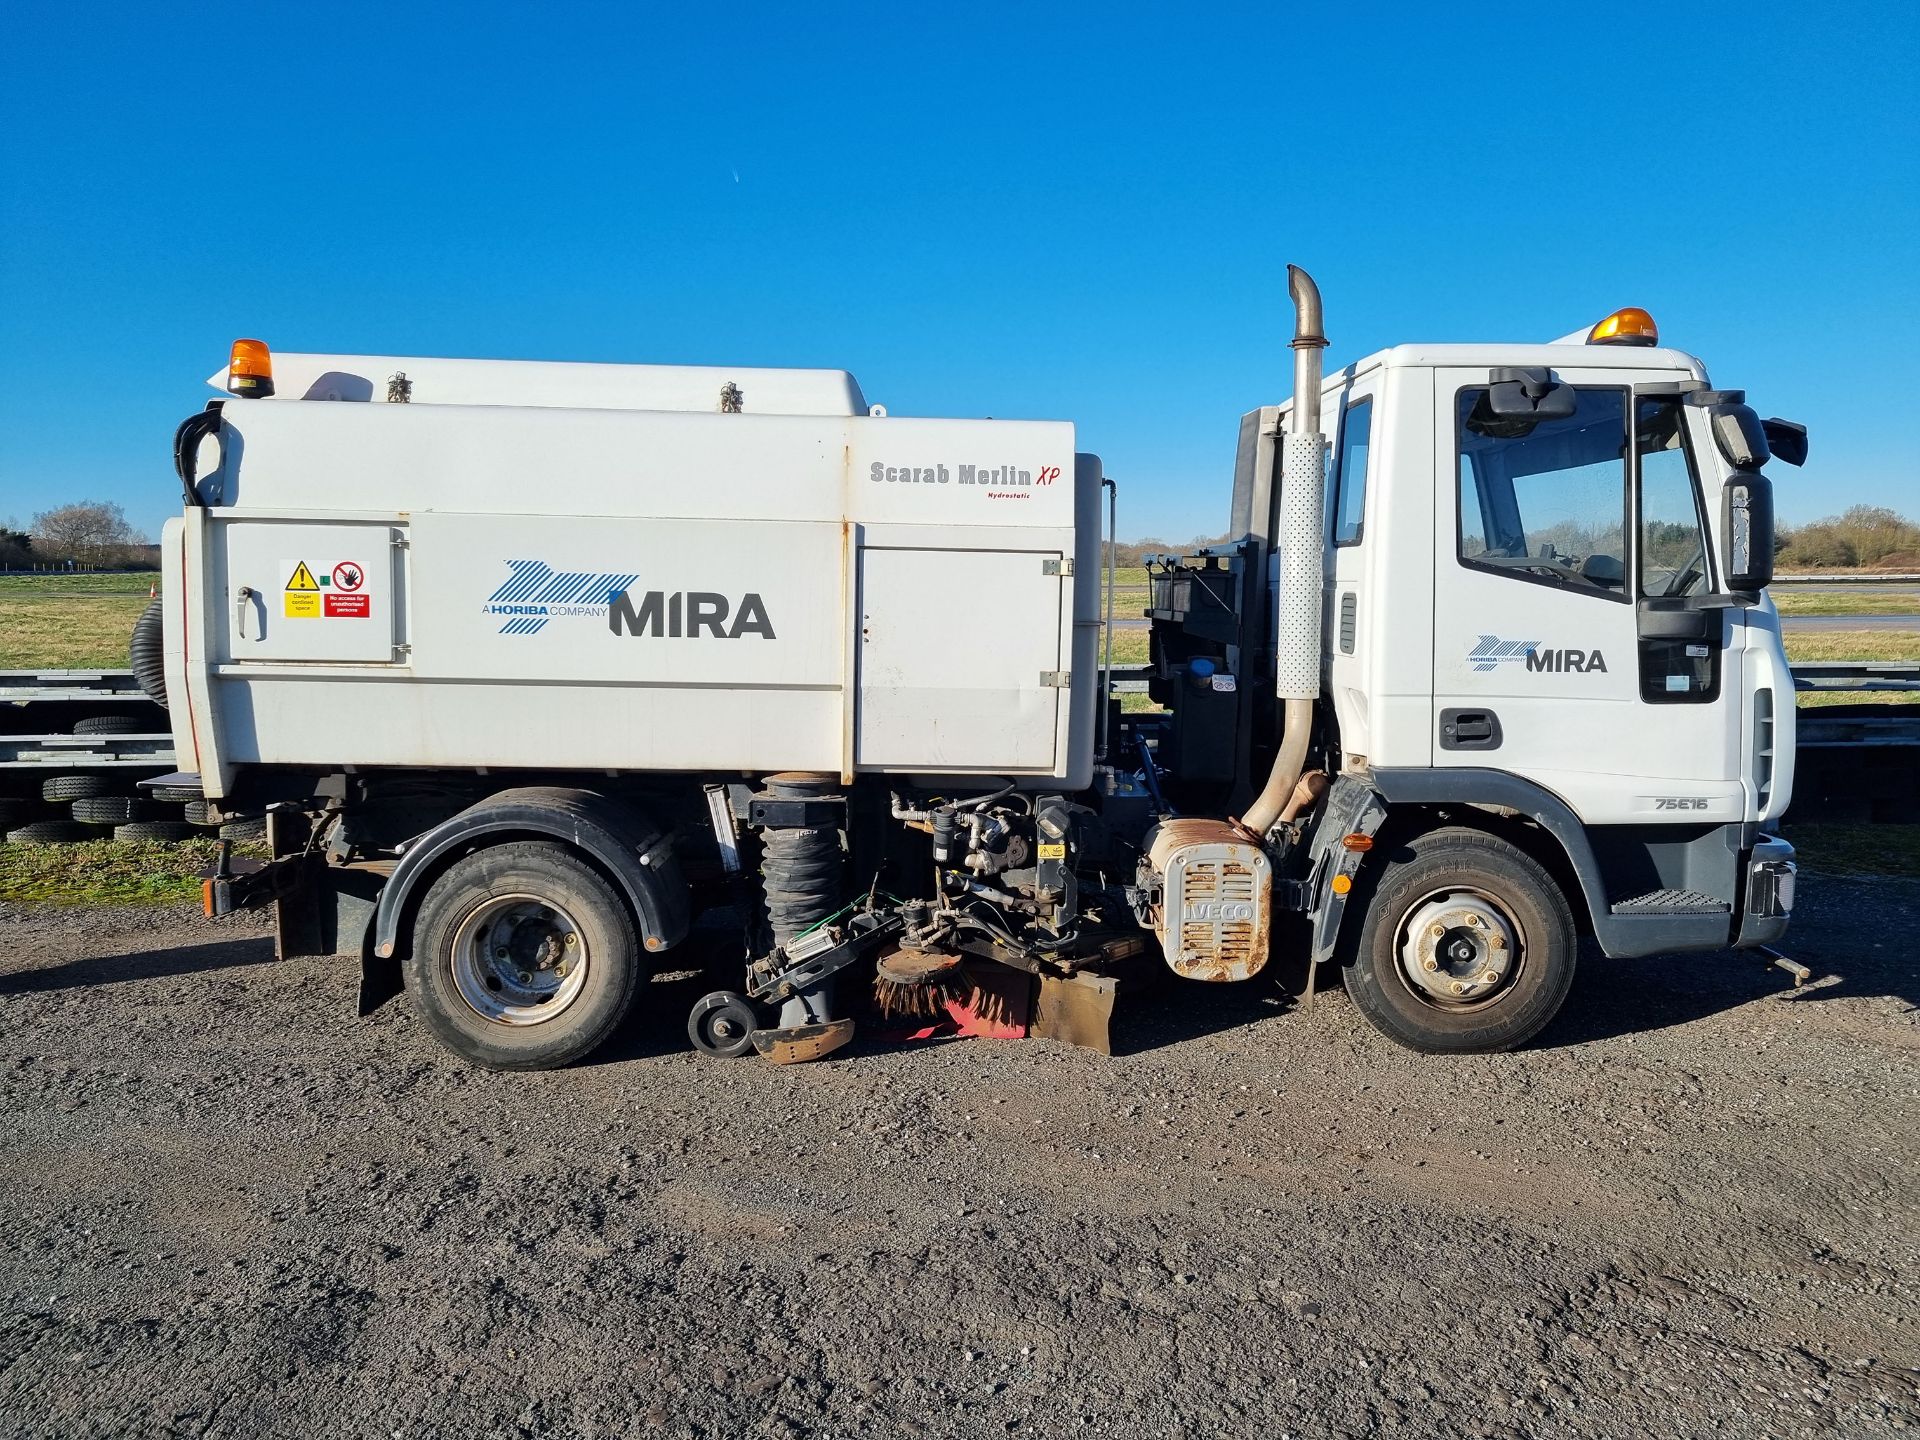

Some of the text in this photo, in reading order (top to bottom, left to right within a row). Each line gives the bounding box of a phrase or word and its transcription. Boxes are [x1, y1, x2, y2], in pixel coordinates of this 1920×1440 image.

[870, 461, 1060, 486] Scarab Merlin XP
[482, 605, 607, 617] A HORIBA COMPANY
[609, 590, 777, 639] MIRA
[1526, 649, 1608, 673] MIRA
[1655, 798, 1708, 810] 75E16
[1183, 904, 1253, 920] IVECO
